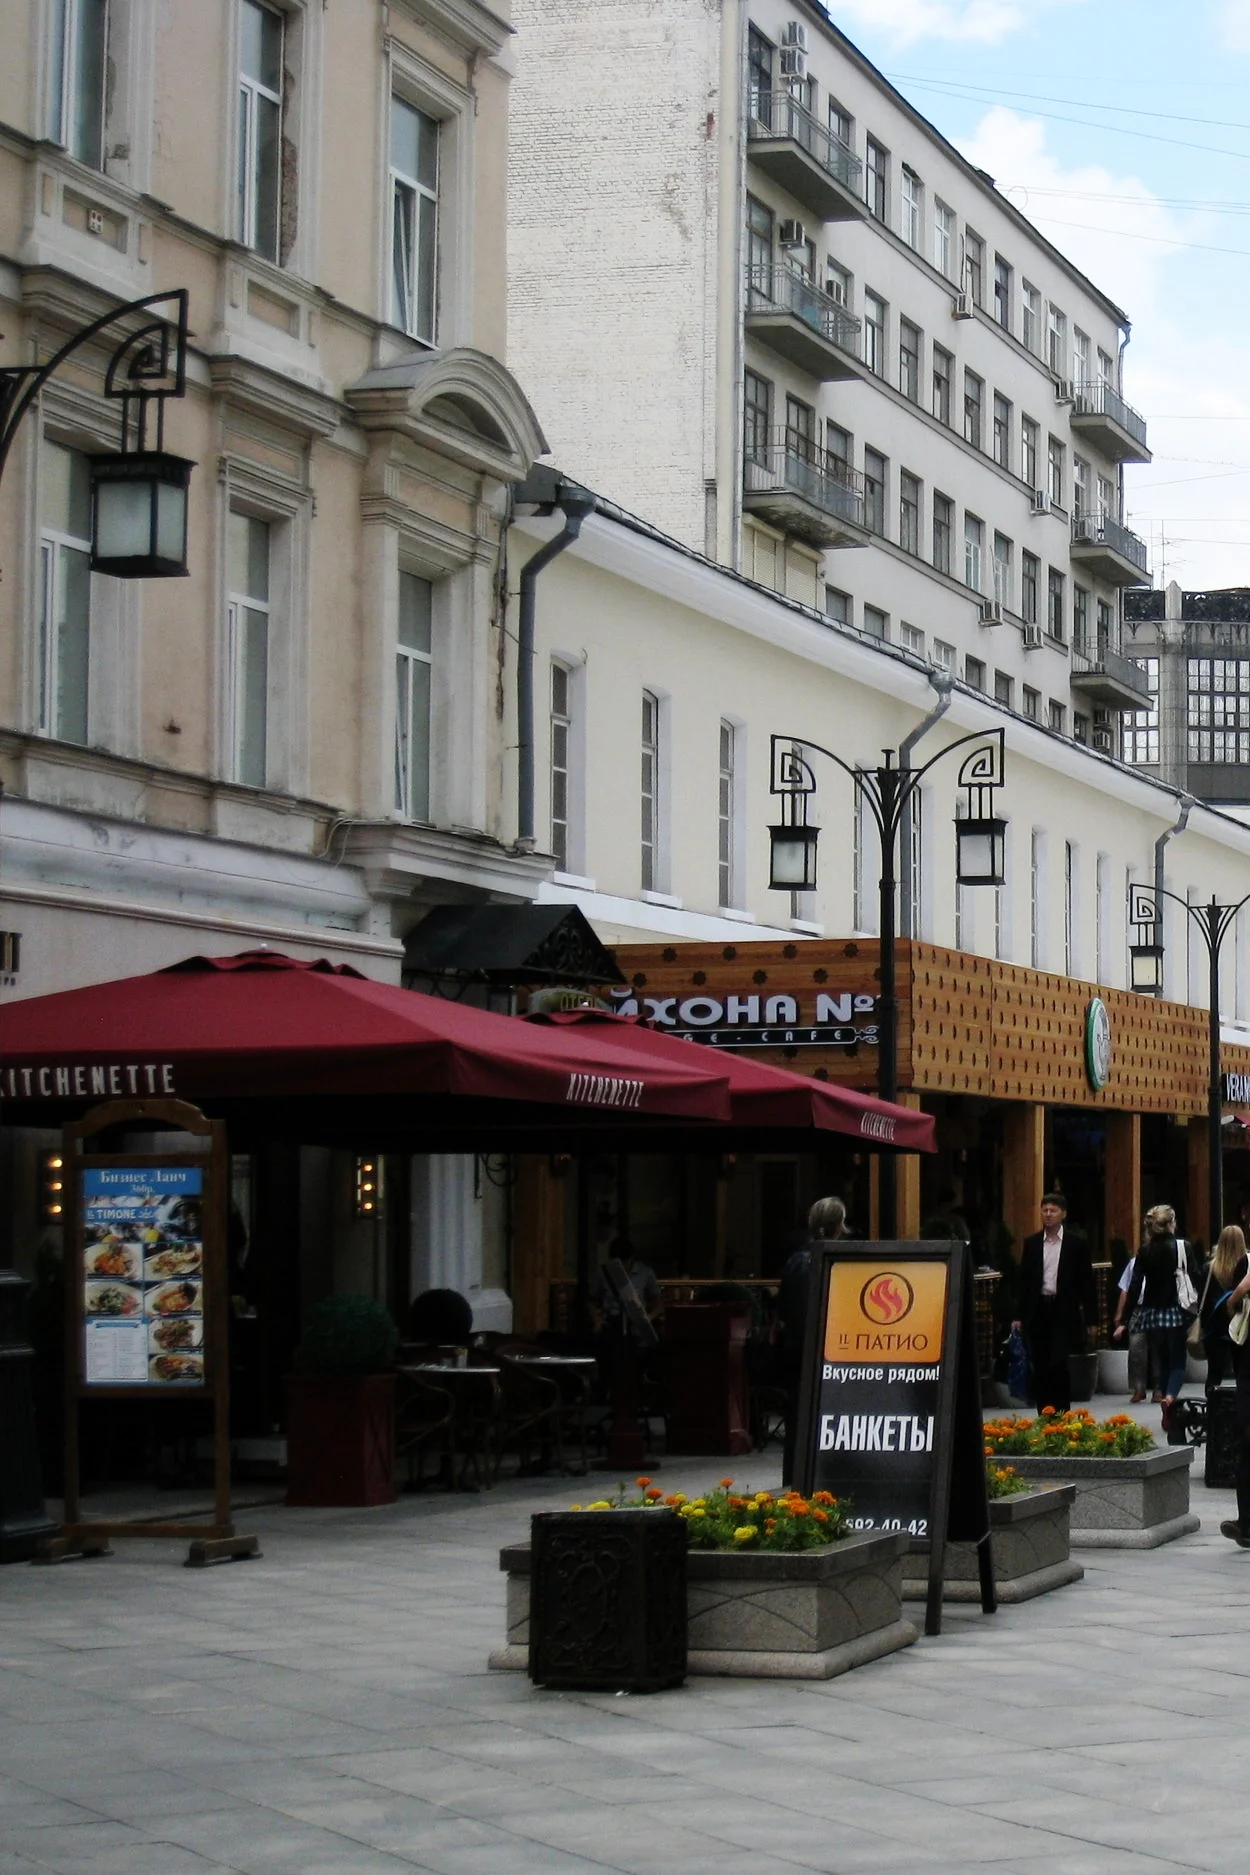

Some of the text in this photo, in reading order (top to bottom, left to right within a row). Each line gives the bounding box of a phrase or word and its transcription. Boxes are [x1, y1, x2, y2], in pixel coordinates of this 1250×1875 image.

[0, 1064, 175, 1097] ITCHENETTE
[566, 1072, 644, 1107] KITCHENETTE
[97, 1209, 136, 1219] TIMONE
[855, 1334, 928, 1351] ПАТИО
[822, 1364, 940, 1383] Вкусное рядом!
[819, 1414, 935, 1452] БАНКЕТЫ
